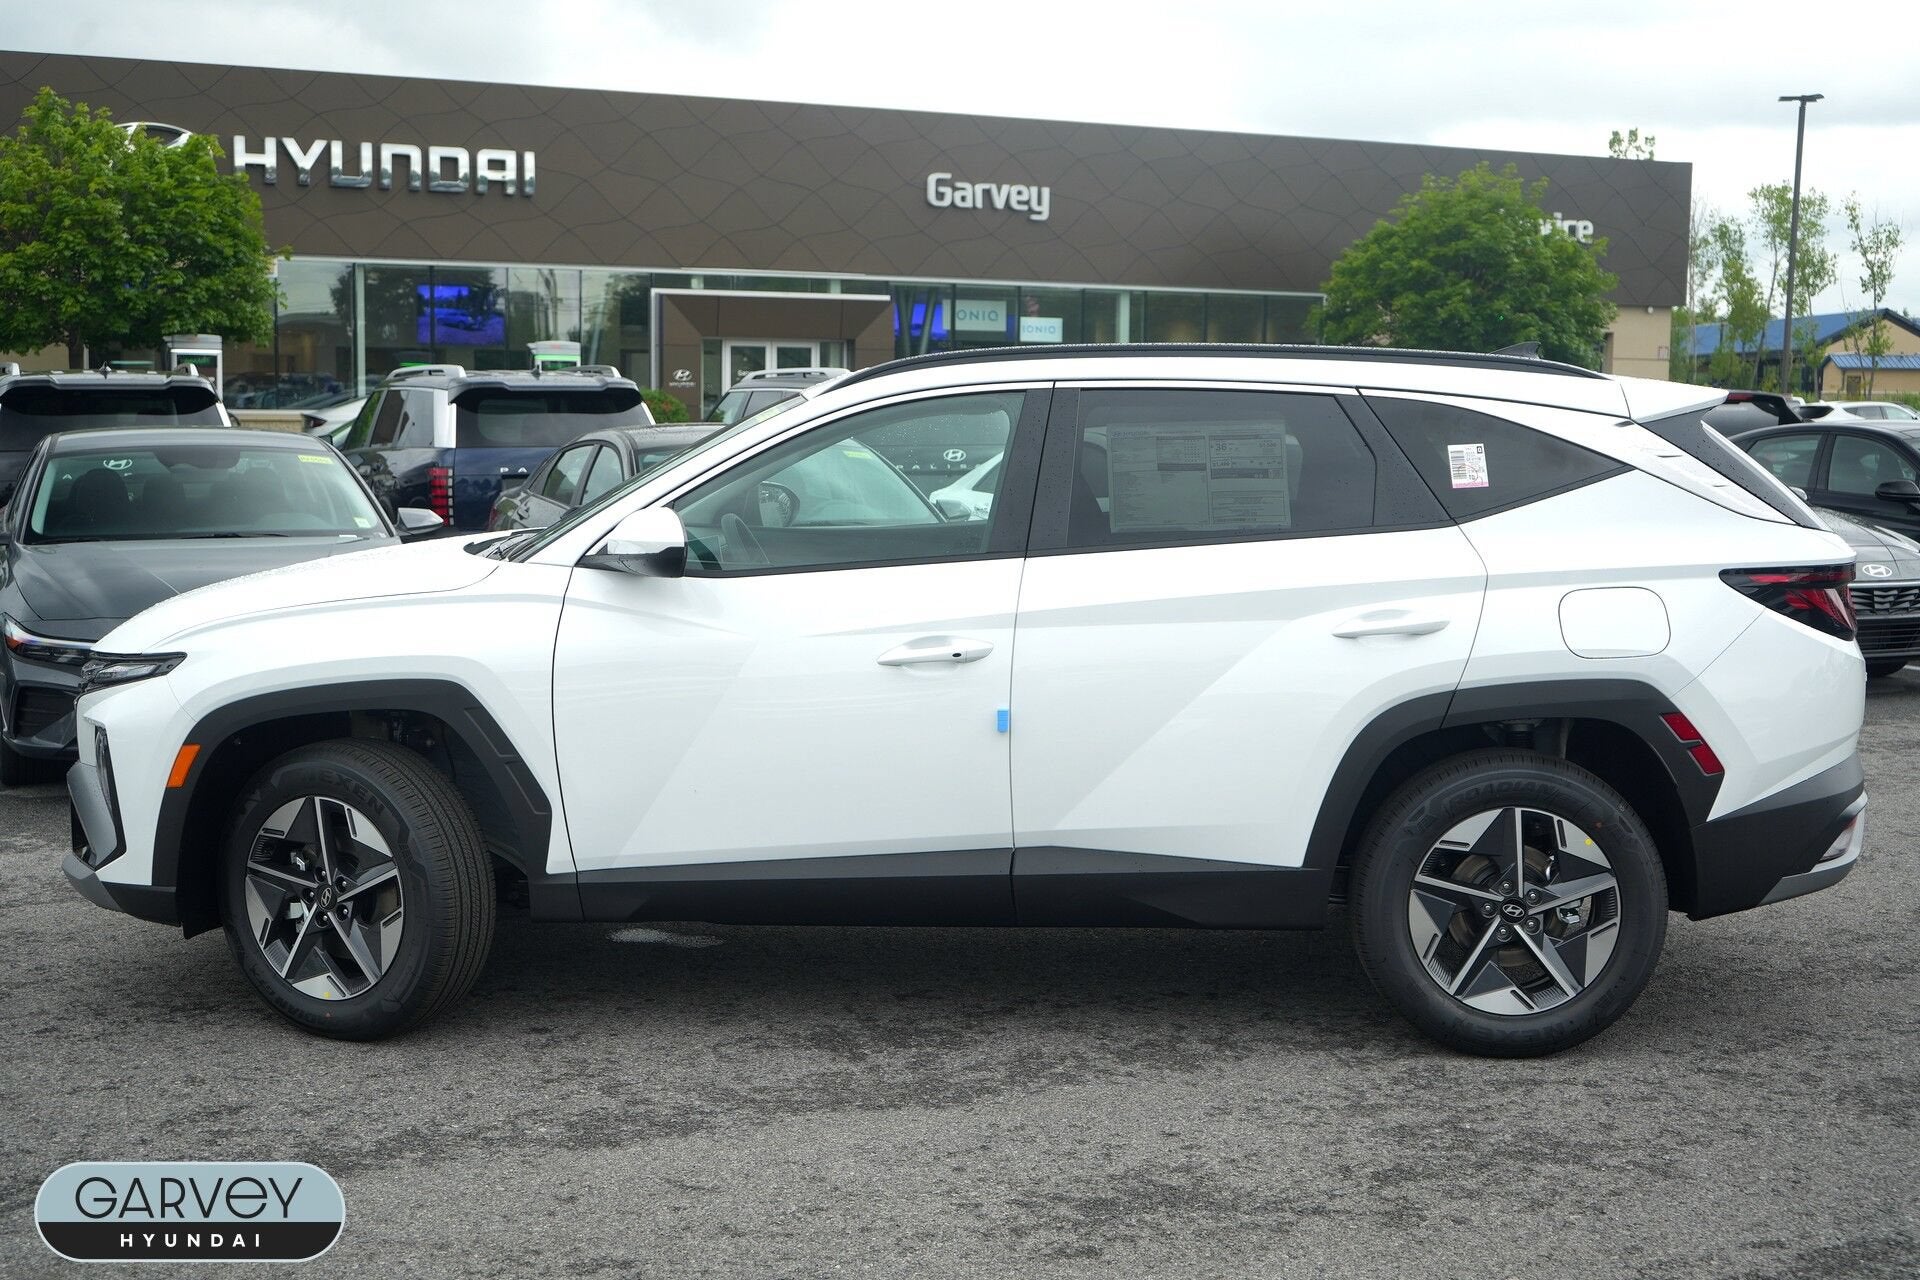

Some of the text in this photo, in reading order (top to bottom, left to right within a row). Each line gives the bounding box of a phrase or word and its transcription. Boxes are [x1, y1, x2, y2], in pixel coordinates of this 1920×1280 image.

[233, 135, 536, 197] HYUNDAI
[926, 172, 1051, 221] Garvey
[1539, 211, 1594, 244] vice
[956, 309, 999, 322] ONIQ
[1022, 324, 1057, 335] IONIQ
